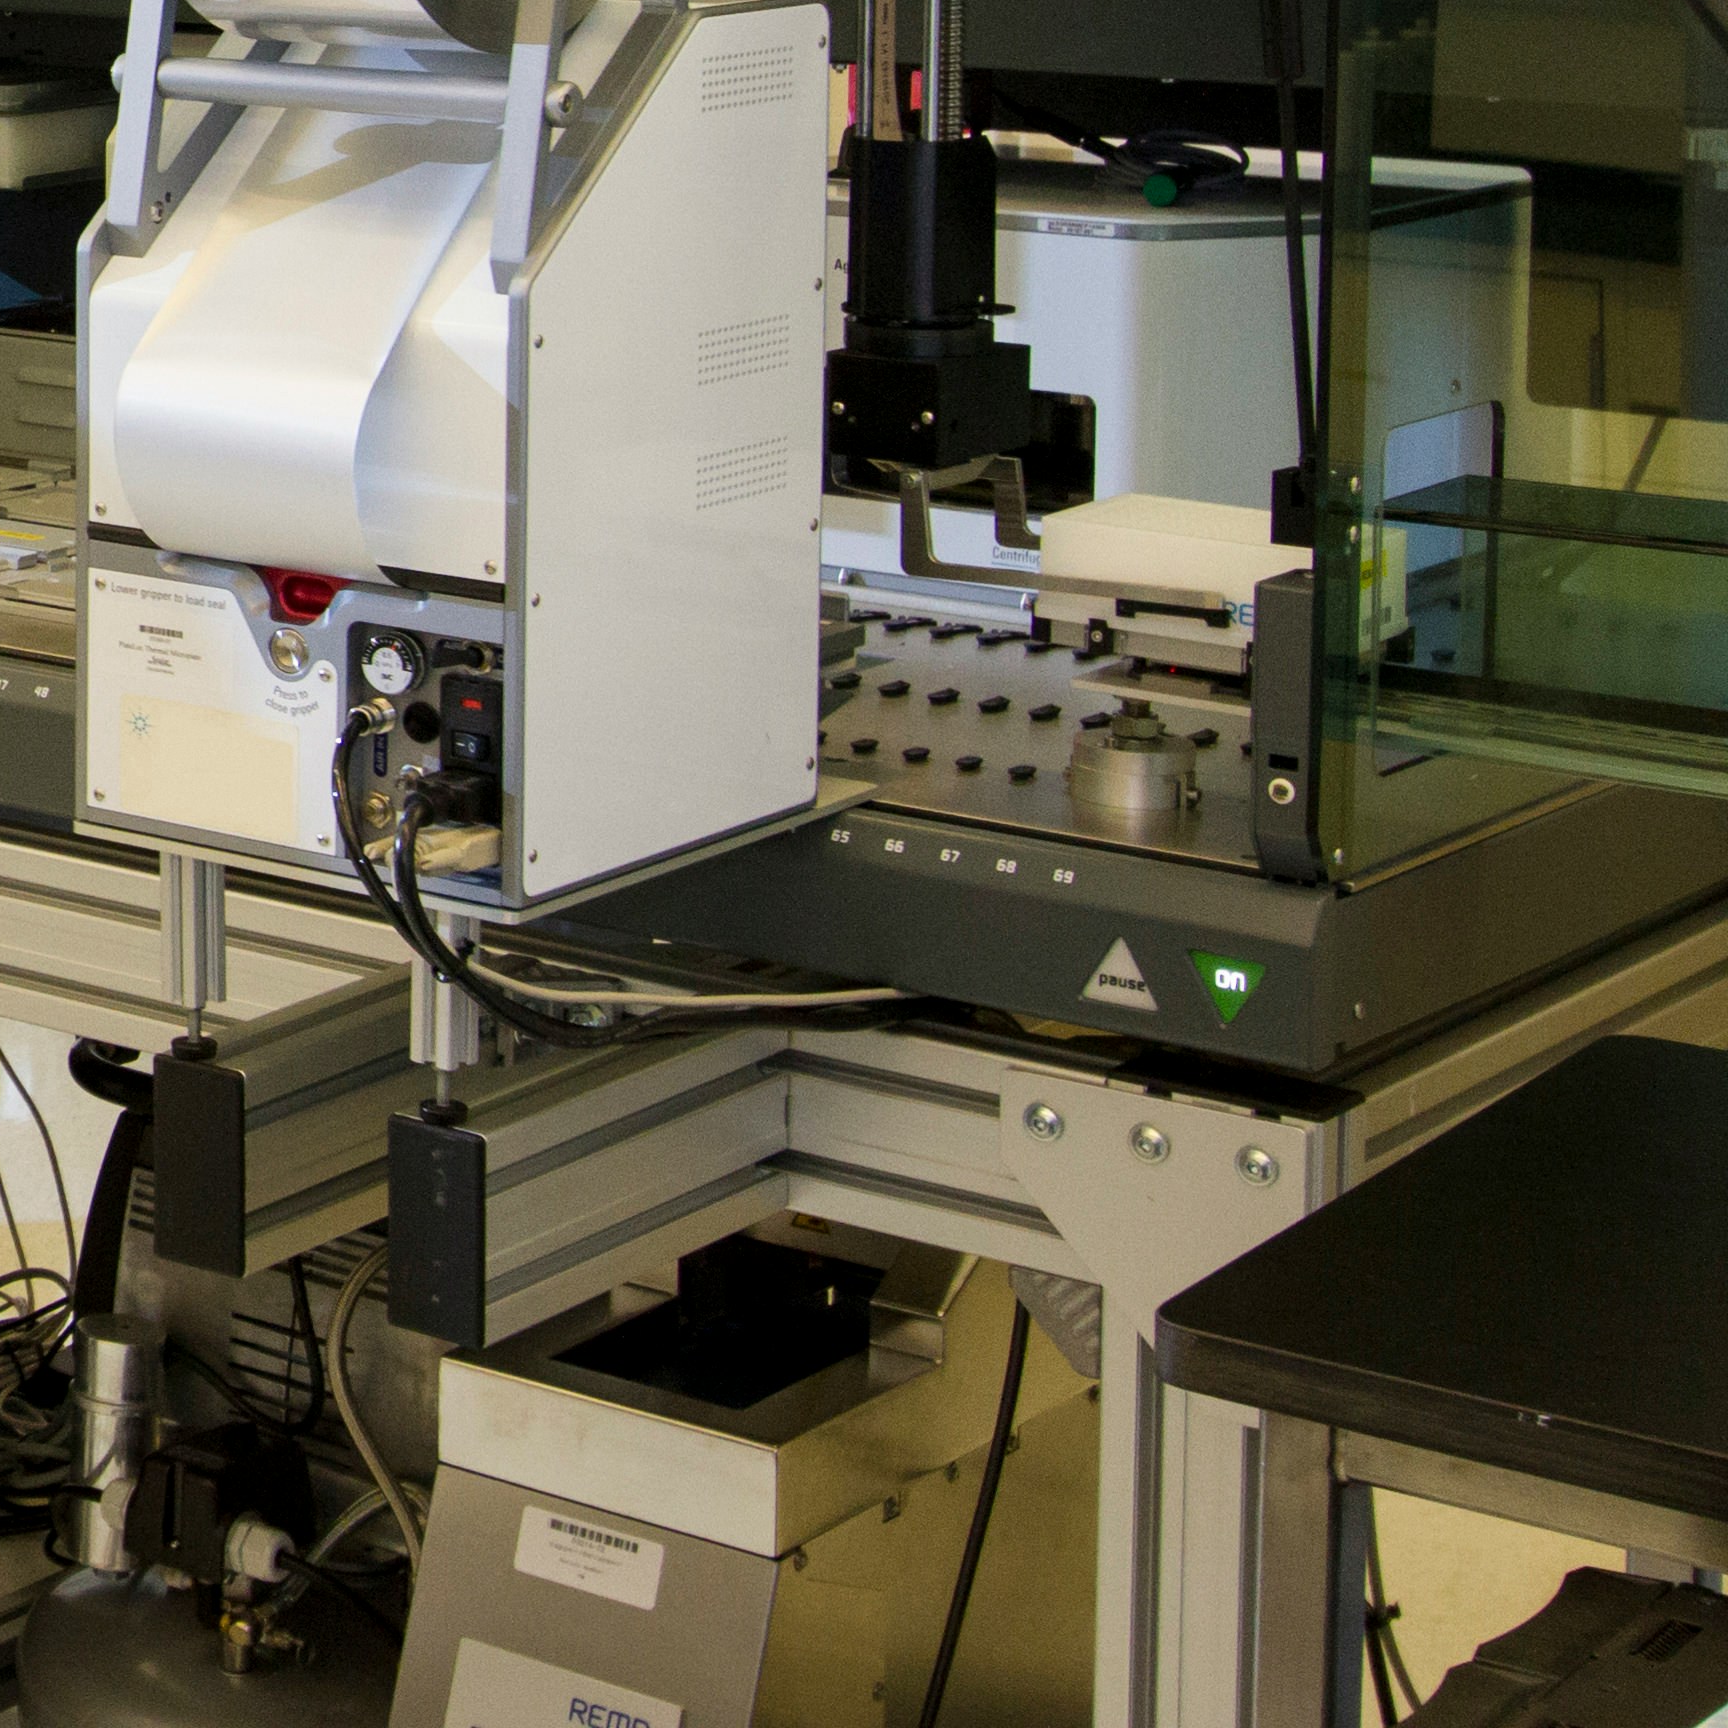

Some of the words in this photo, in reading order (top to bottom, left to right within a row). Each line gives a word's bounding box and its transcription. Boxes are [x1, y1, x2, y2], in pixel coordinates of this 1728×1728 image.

[110, 582, 139, 597] Lower
[140, 588, 171, 602] gripper
[174, 592, 184, 603] to
[186, 593, 205, 607] load
[207, 598, 226, 610] seal
[273, 685, 297, 701] Press
[298, 689, 309, 700] to
[265, 697, 289, 714] close
[290, 700, 320, 718] gripper
[34, 685, 50, 699] 48
[831, 828, 851, 845] 65
[884, 838, 905, 854] 66
[940, 848, 961, 864] 67
[996, 857, 1018, 875] 68
[1052, 867, 1075, 885] 69
[1099, 973, 1147, 994] pause
